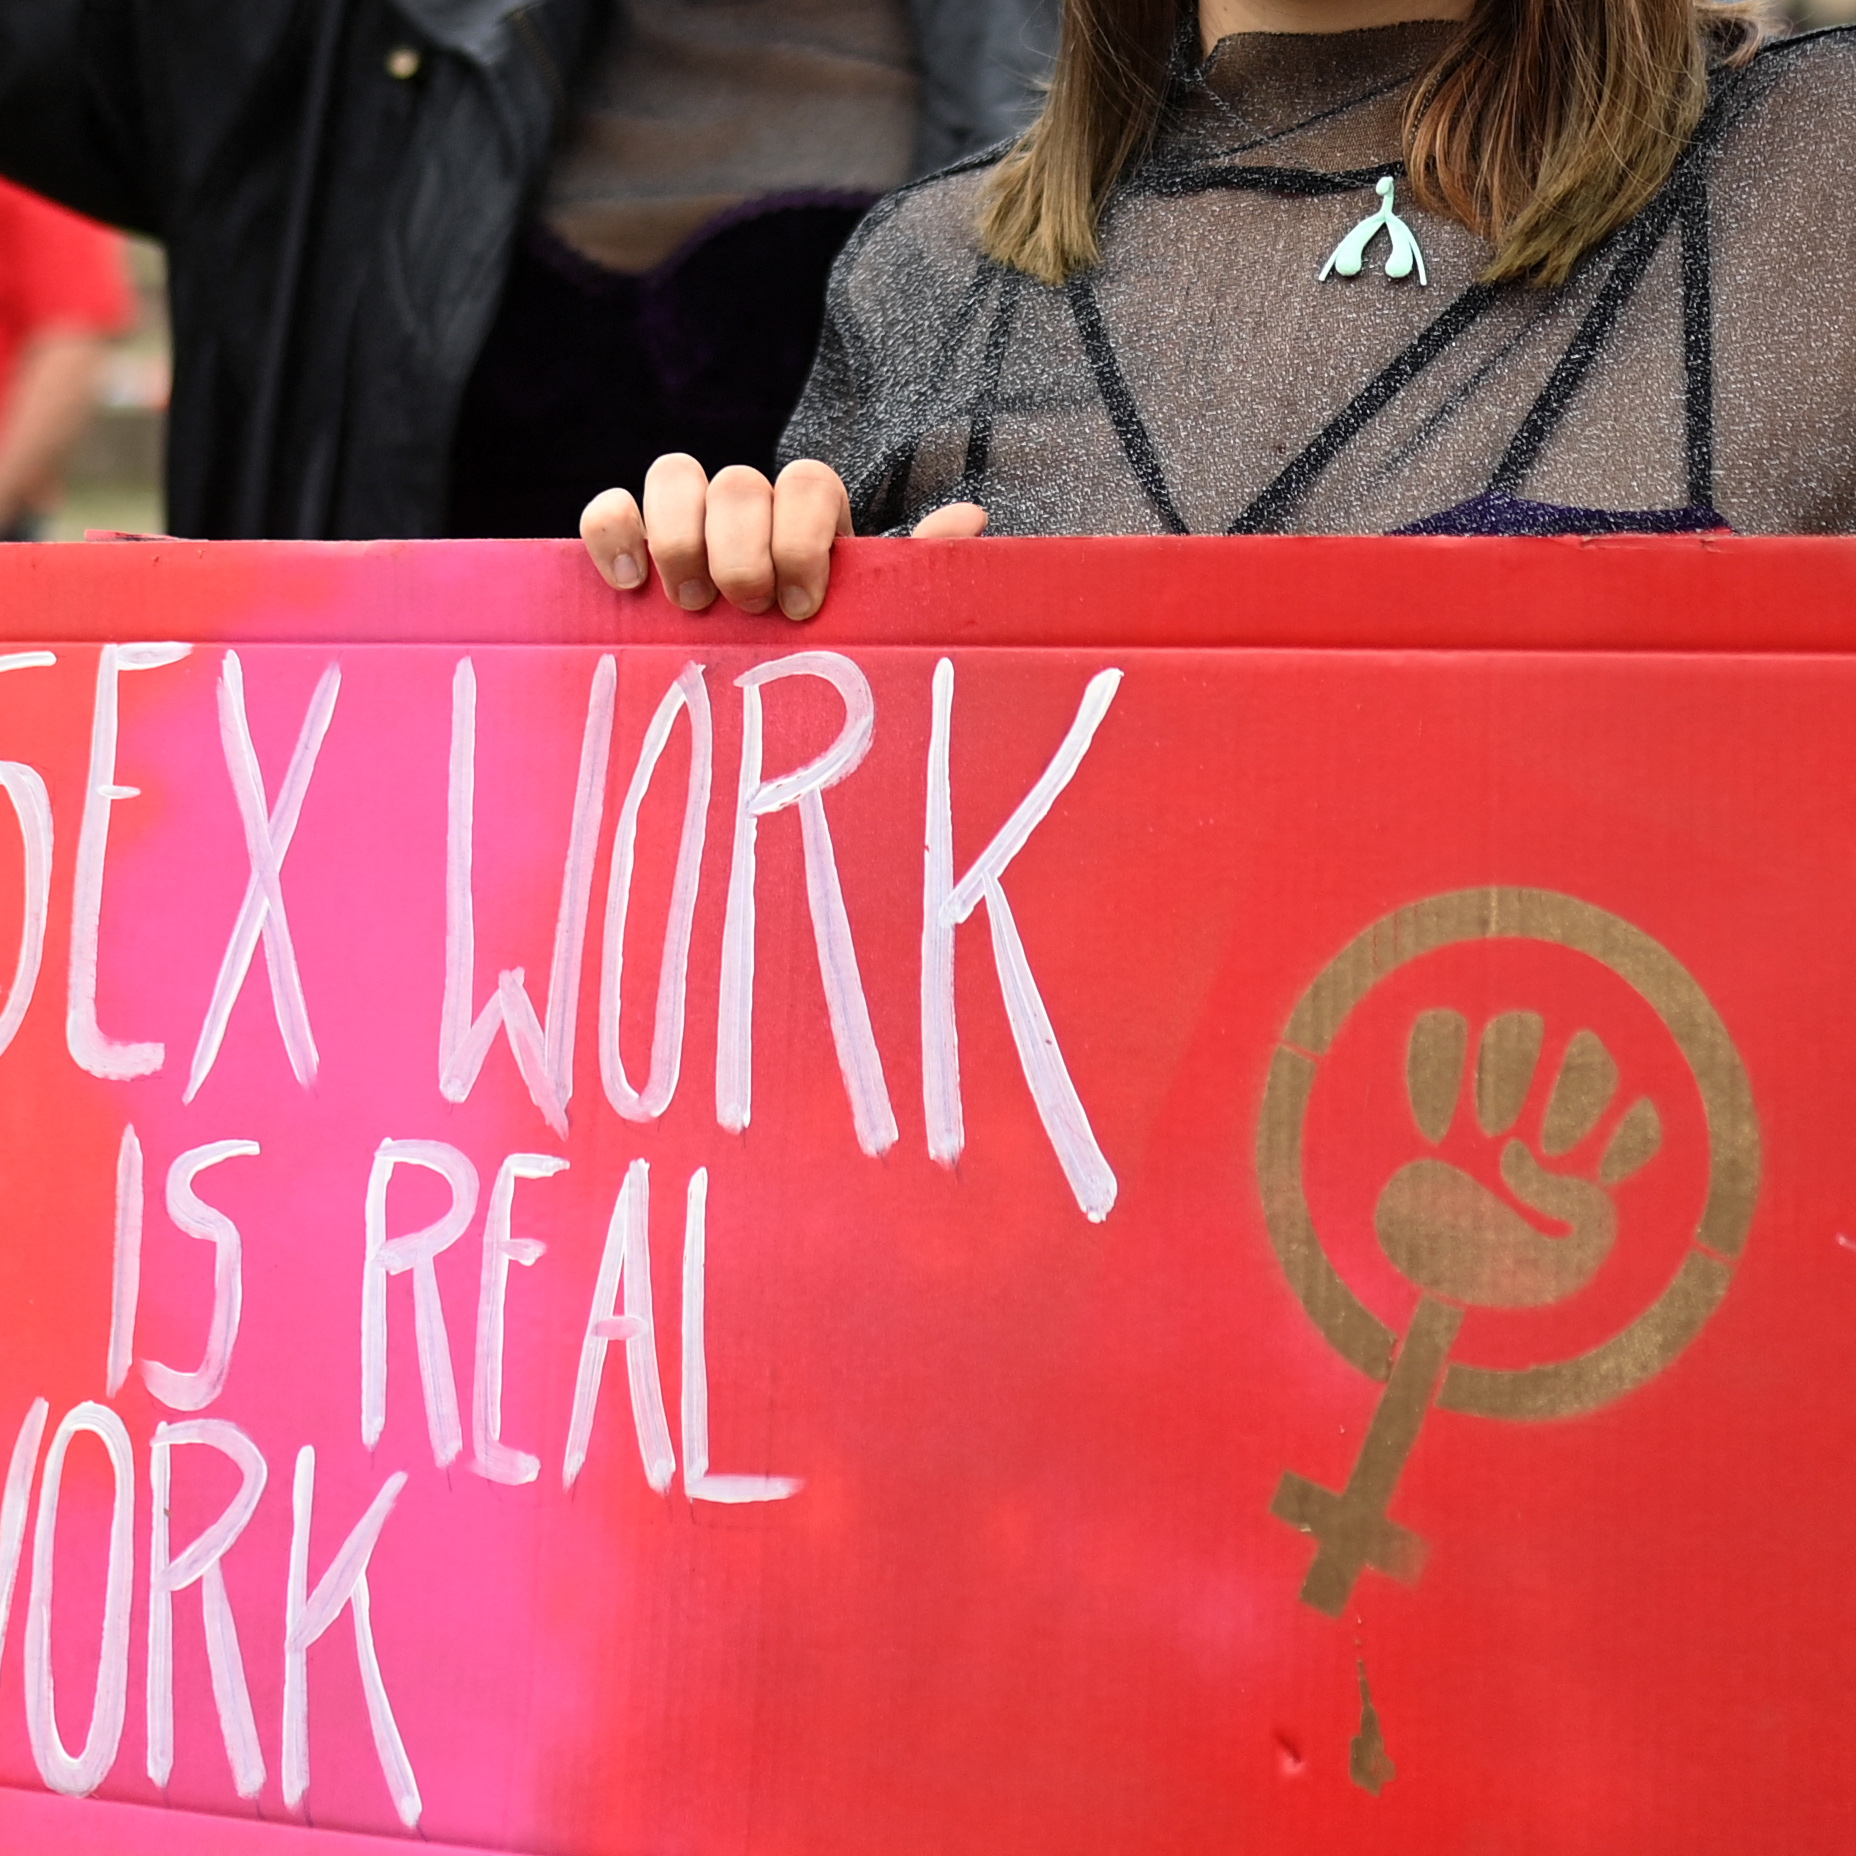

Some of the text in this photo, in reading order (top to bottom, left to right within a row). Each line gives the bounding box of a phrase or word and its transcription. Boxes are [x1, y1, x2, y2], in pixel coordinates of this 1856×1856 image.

[438, 649, 1124, 1226] WORK
[105, 1123, 806, 1504] IS REAL
